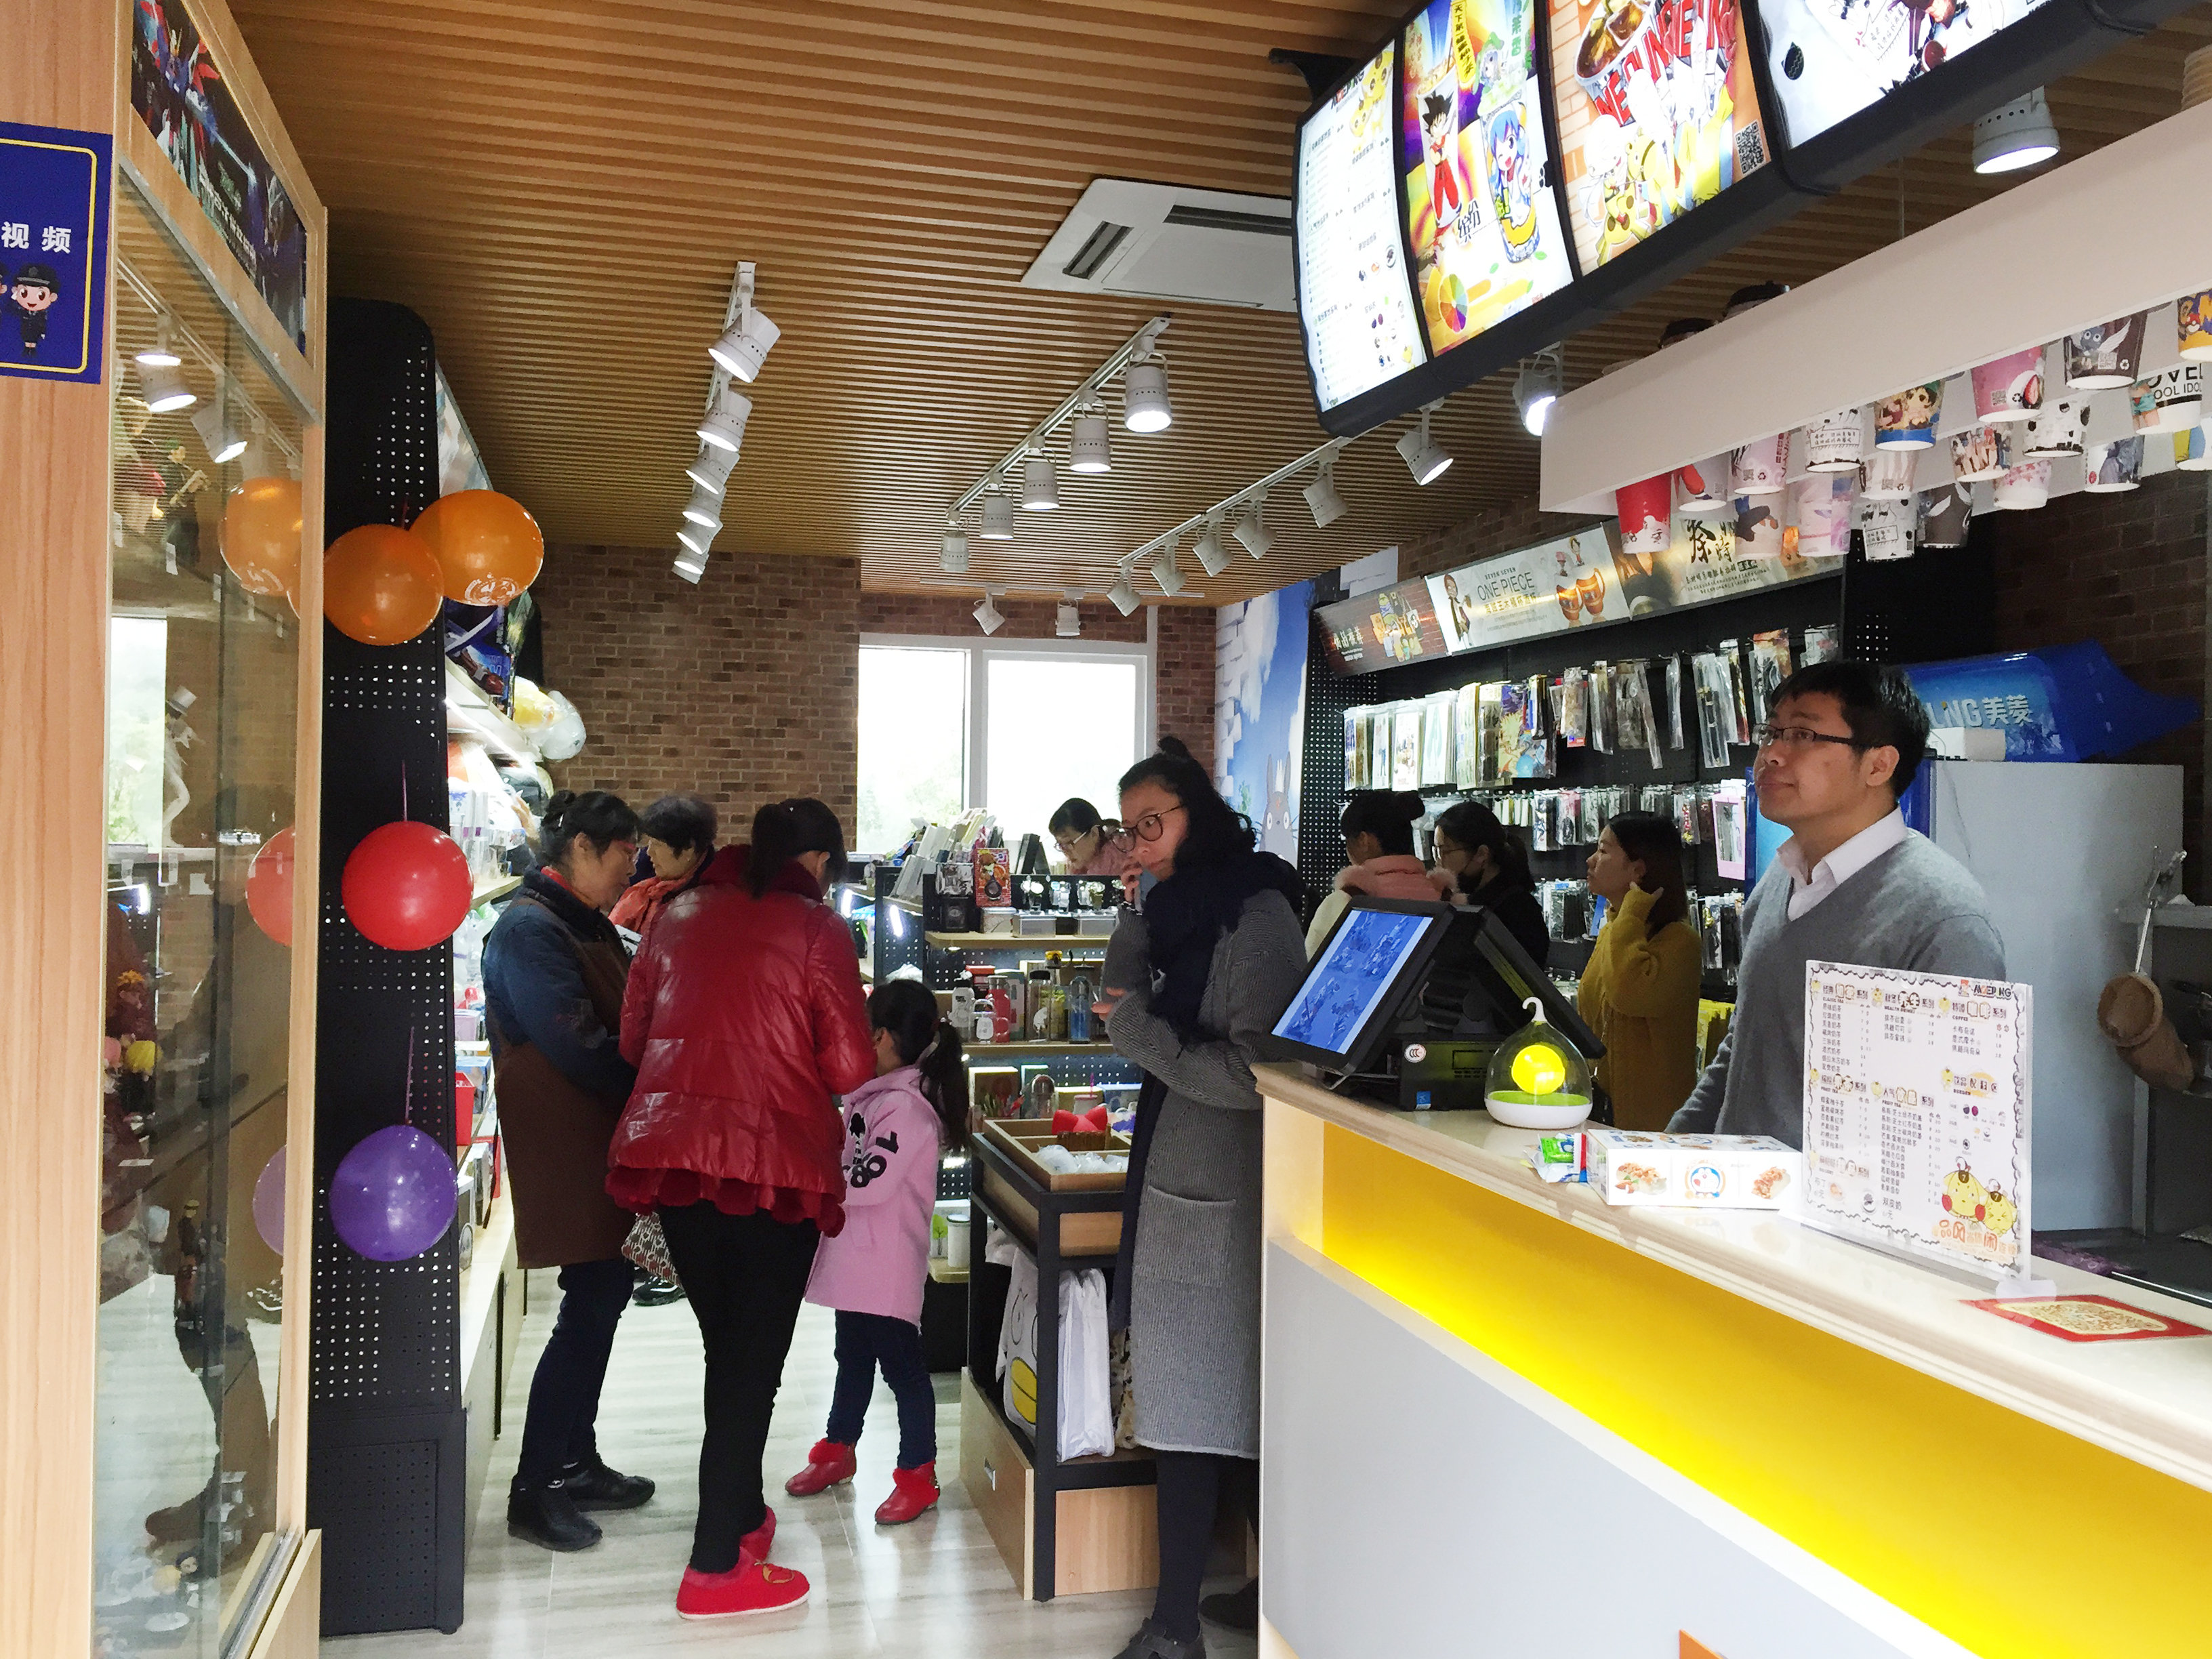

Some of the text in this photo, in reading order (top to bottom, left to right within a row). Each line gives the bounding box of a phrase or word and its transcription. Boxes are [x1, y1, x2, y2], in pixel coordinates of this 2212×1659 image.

[1477, 572, 1535, 601] ONE PIECE
[1982, 695, 2033, 726] 美菱
